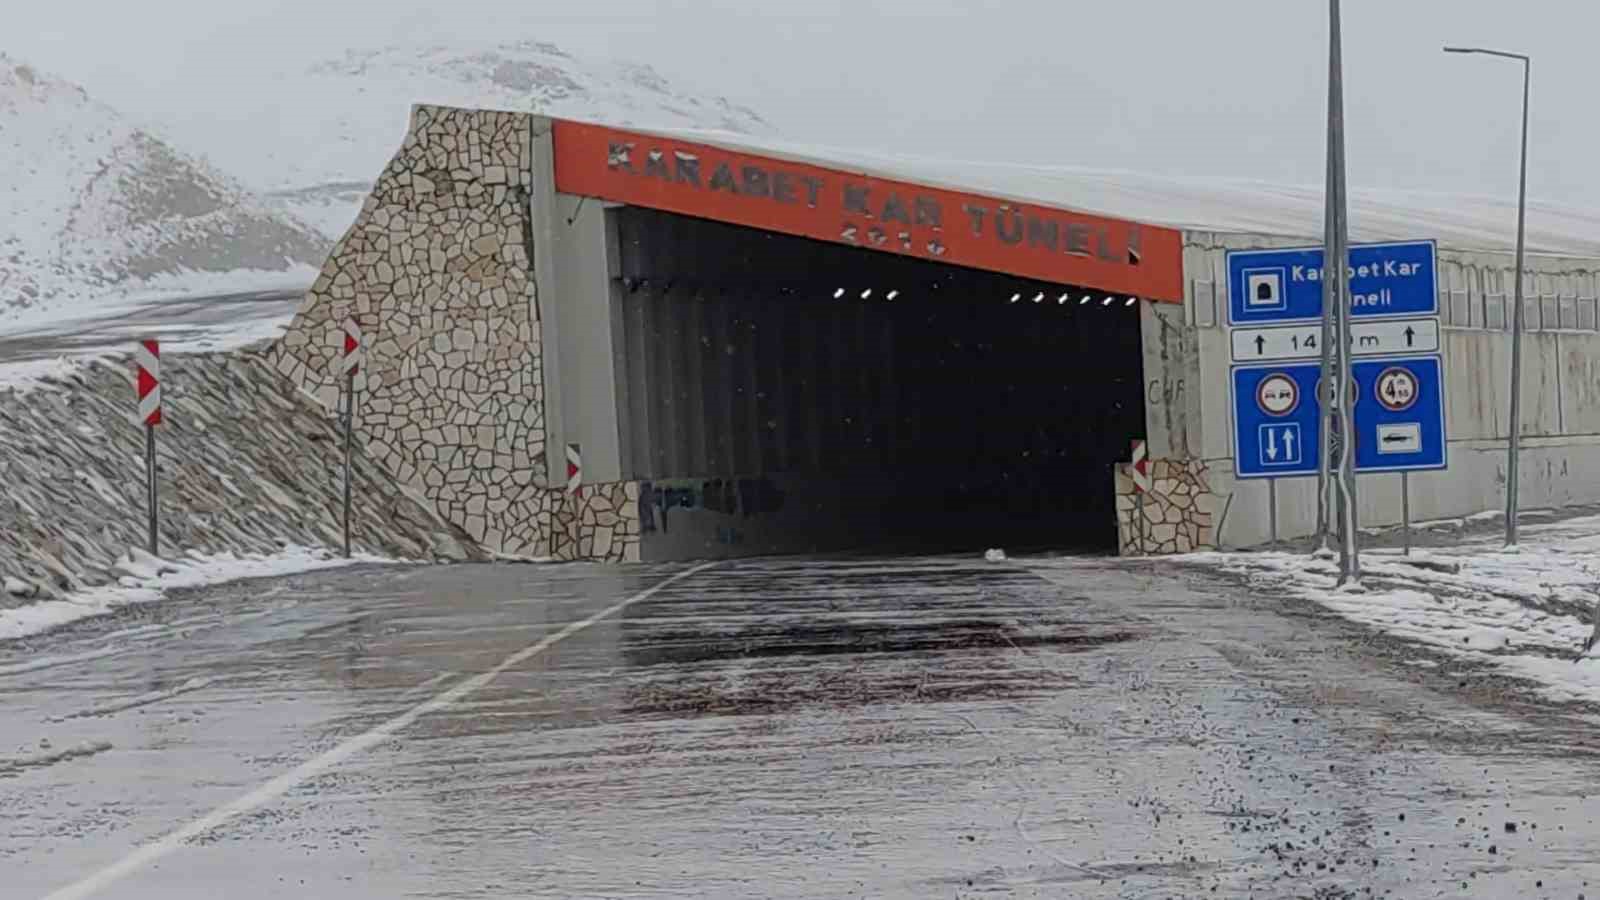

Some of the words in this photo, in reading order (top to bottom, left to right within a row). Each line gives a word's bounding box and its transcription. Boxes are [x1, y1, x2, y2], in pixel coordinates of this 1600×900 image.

[607, 141, 823, 208] KARABET
[843, 184, 943, 226] KAR
[1291, 261, 1379, 282] Kaet
[1384, 259, 1421, 277] Kar
[1360, 335, 1379, 347] m
